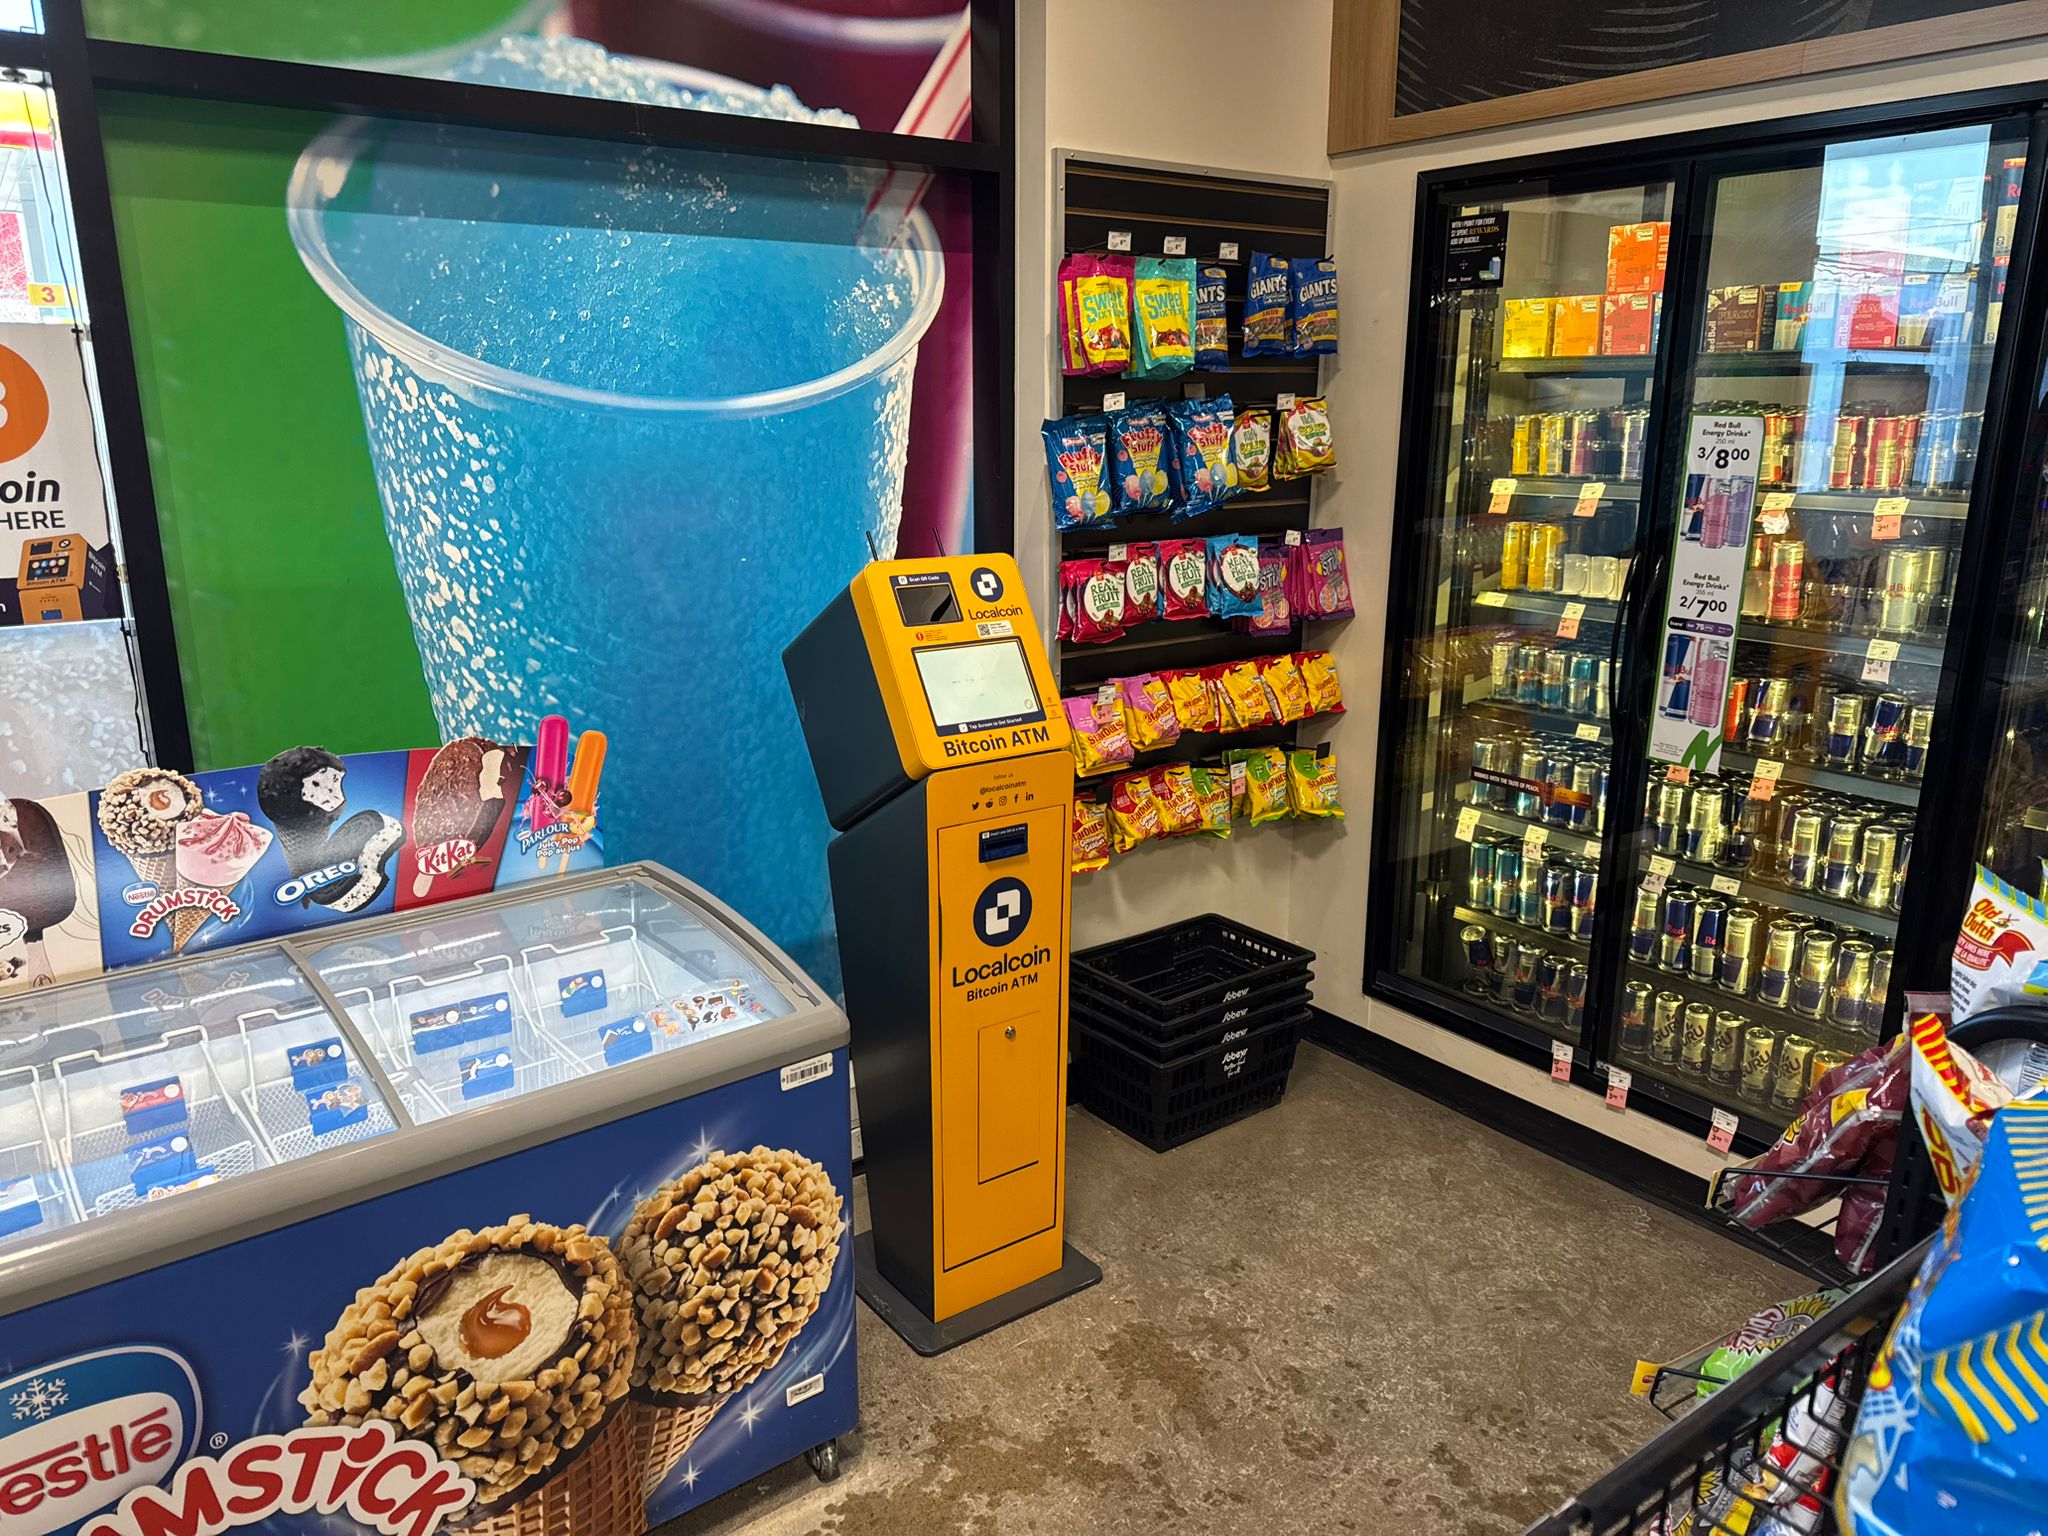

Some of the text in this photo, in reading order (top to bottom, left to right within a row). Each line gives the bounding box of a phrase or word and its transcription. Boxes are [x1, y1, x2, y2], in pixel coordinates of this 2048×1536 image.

[41, 287, 56, 304] 3
[1250, 276, 1287, 299] GIANTS
[1300, 278, 1337, 302] GIANTS
[1702, 429, 1725, 438] Energy
[1131, 442, 1155, 454] Stuff
[1130, 564, 1153, 580] REAL
[1174, 560, 1200, 574] REAL
[1134, 574, 1155, 590] FRUIT
[1178, 569, 1202, 583] FRUIT
[1683, 579, 1706, 589] Energy
[1091, 581, 1119, 595] REAL
[1093, 591, 1120, 606] FRUIT
[968, 604, 1023, 621] Localcoin
[943, 726, 1050, 757] Bitcoin ATM
[979, 780, 1027, 796] @localcoinatm
[1508, 779, 1519, 788] TASTE
[521, 823, 569, 853] PARLOUR
[539, 837, 579, 850] Juicy Pop
[425, 840, 473, 873] KitKat
[536, 849, 554, 859] Pop
[567, 845, 580, 854] jus
[277, 861, 357, 904] OREO
[131, 889, 239, 937] DRUMSTICK
[1974, 898, 2003, 920] Old
[1964, 911, 1996, 942] Dutch
[952, 945, 1051, 988] Localcoin
[966, 972, 1039, 1002] Bitcoin ATM
[80, 1428, 467, 1536] MSTICK
